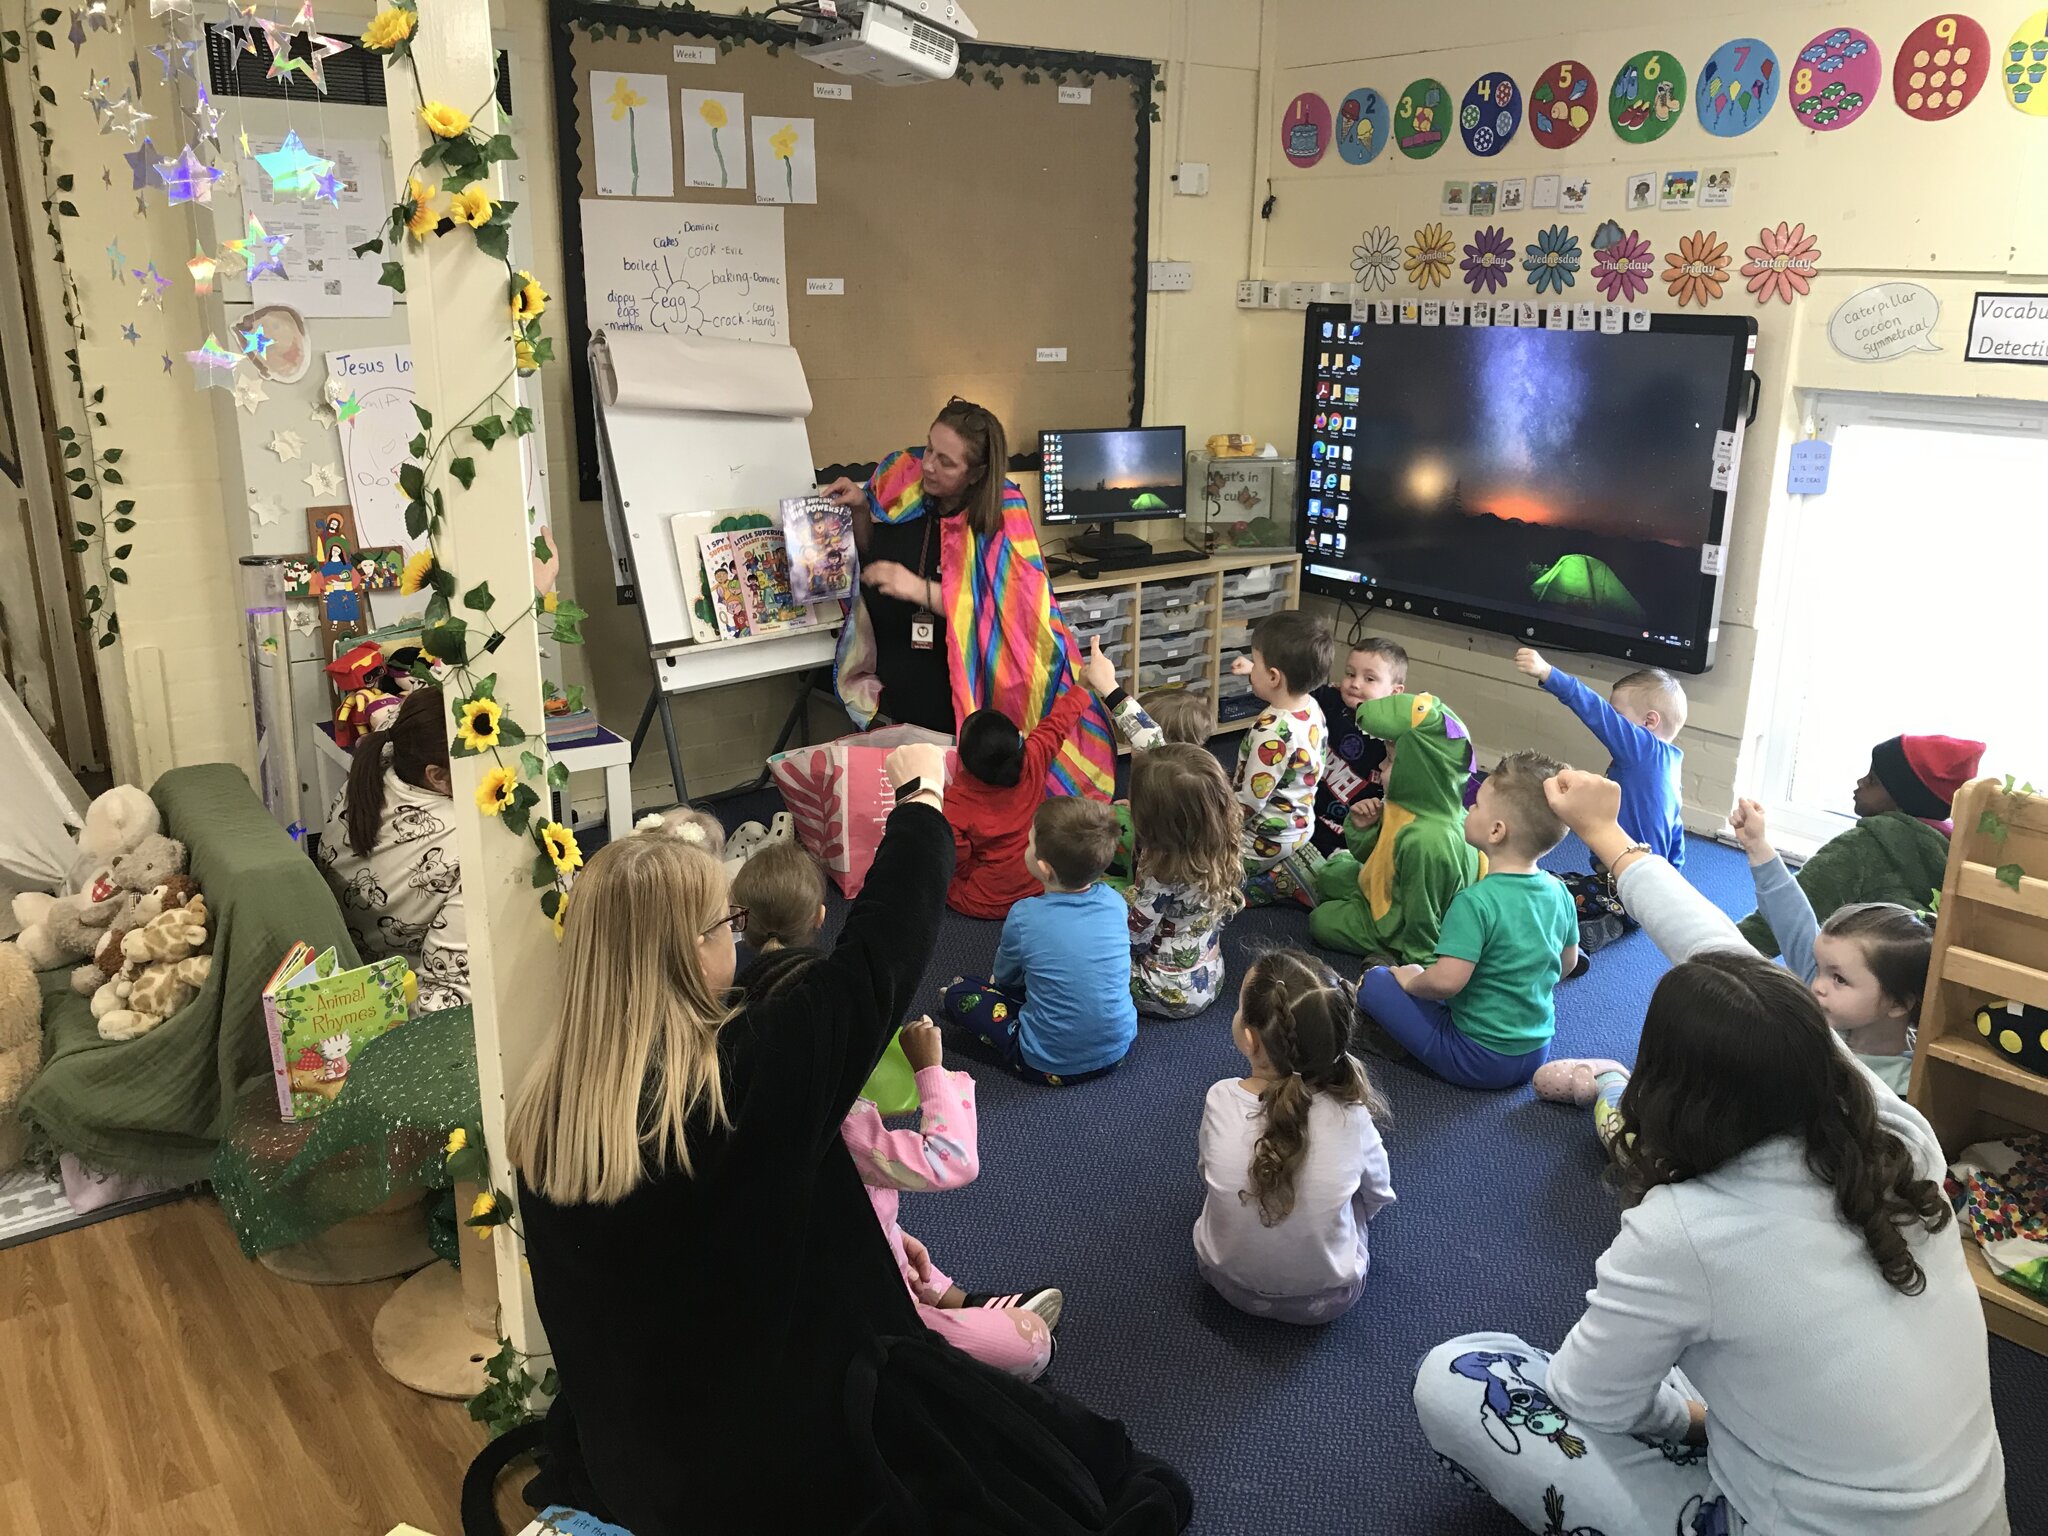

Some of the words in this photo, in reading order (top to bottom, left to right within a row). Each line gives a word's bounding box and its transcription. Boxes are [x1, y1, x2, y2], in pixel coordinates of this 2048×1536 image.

[1936, 18, 1957, 45] 9
[676, 50, 697, 59] Week
[1734, 46, 1751, 72] 7
[1559, 65, 1572, 88] 5
[1643, 56, 1661, 80] 6
[1794, 68, 1812, 95] 8
[816, 86, 835, 96] Week
[837, 87, 842, 96] 3
[1060, 90, 1075, 98] Week
[1477, 80, 1491, 101] 4
[1296, 100, 1301, 120] 1
[1365, 94, 1376, 114] 2
[1400, 96, 1412, 118] 3
[684, 221, 720, 233] Dominic
[653, 236, 679, 249] Cakes
[623, 257, 660, 272] boiled
[1362, 253, 1393, 266] Sunday
[1415, 250, 1448, 262] Monday
[1472, 254, 1508, 269] Tuesday
[1528, 252, 1581, 268] Wednesday
[1601, 259, 1649, 273] Thursday
[1681, 263, 1716, 275] Friday
[1754, 257, 1812, 273] Saturday
[808, 282, 827, 290] Week
[828, 282, 834, 290] 2
[607, 290, 635, 307] dippy
[617, 307, 640, 325] eggs
[661, 296, 688, 324] egg
[753, 302, 775, 318] Corey
[1844, 291, 1917, 325] caterpillar
[713, 311, 744, 328] crack
[1854, 316, 1902, 341] cocoon
[1863, 316, 1930, 359] symmetrical
[336, 355, 385, 377] Jesus
[1248, 471, 1259, 483] in
[711, 538, 725, 548] SPY
[734, 532, 753, 546] LITTLE
[317, 982, 367, 1013] Animal
[312, 1005, 377, 1034] Rhymes
